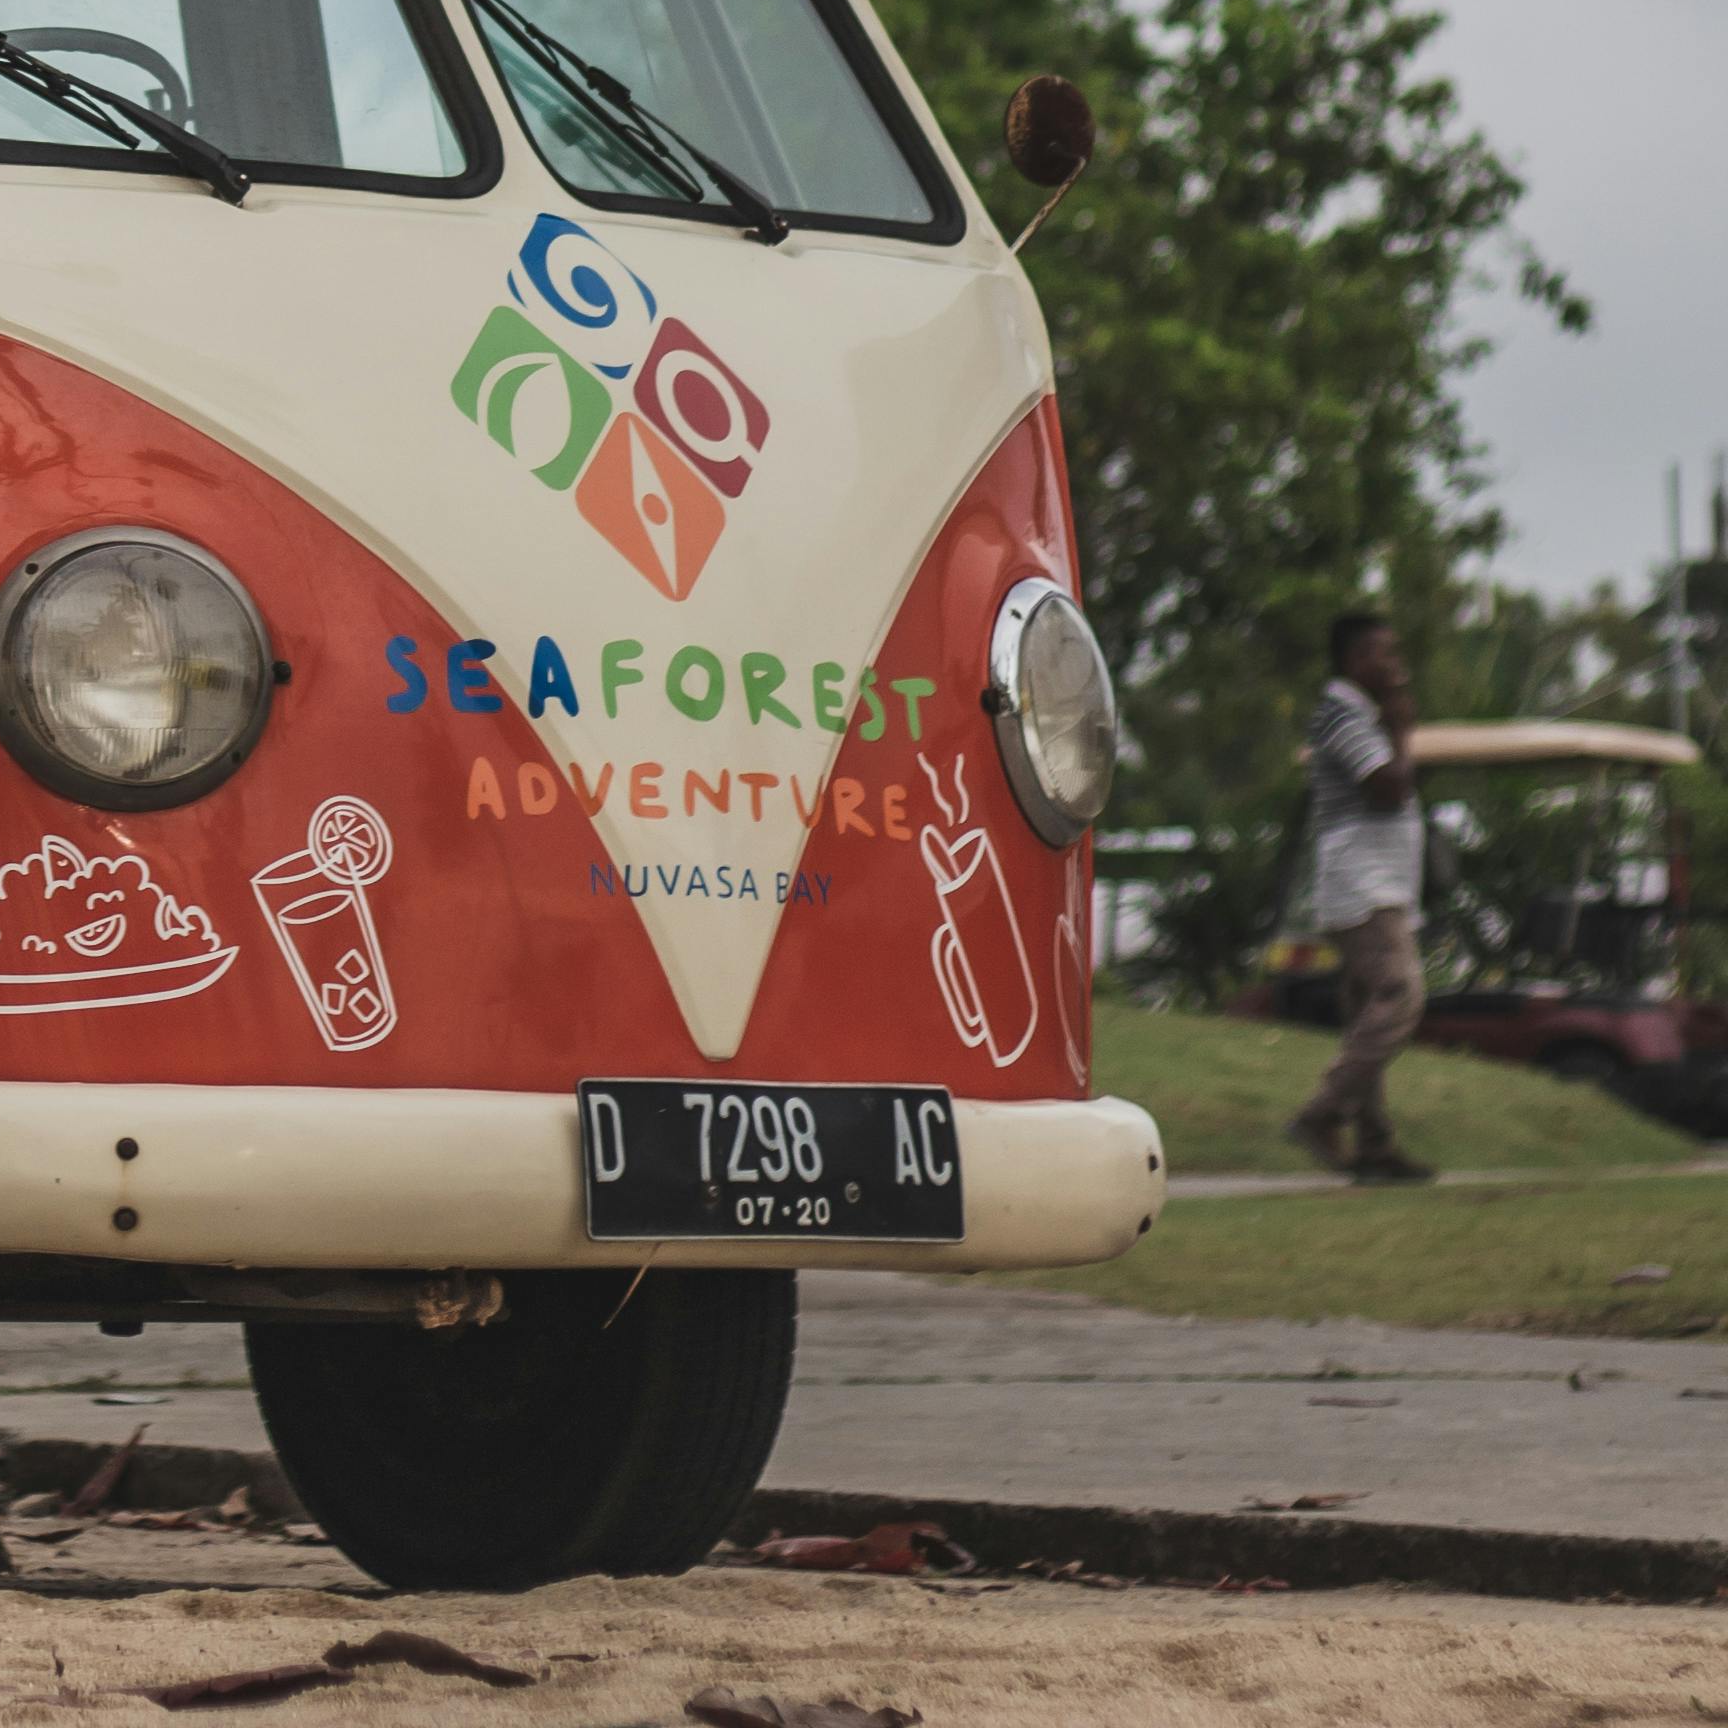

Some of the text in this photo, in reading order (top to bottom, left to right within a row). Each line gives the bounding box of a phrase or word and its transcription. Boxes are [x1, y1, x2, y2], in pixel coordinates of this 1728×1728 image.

[467, 757, 913, 842] ADVENTURE
[590, 863, 833, 905] NUVASA BAY
[588, 1093, 953, 1186] D 7298 AC
